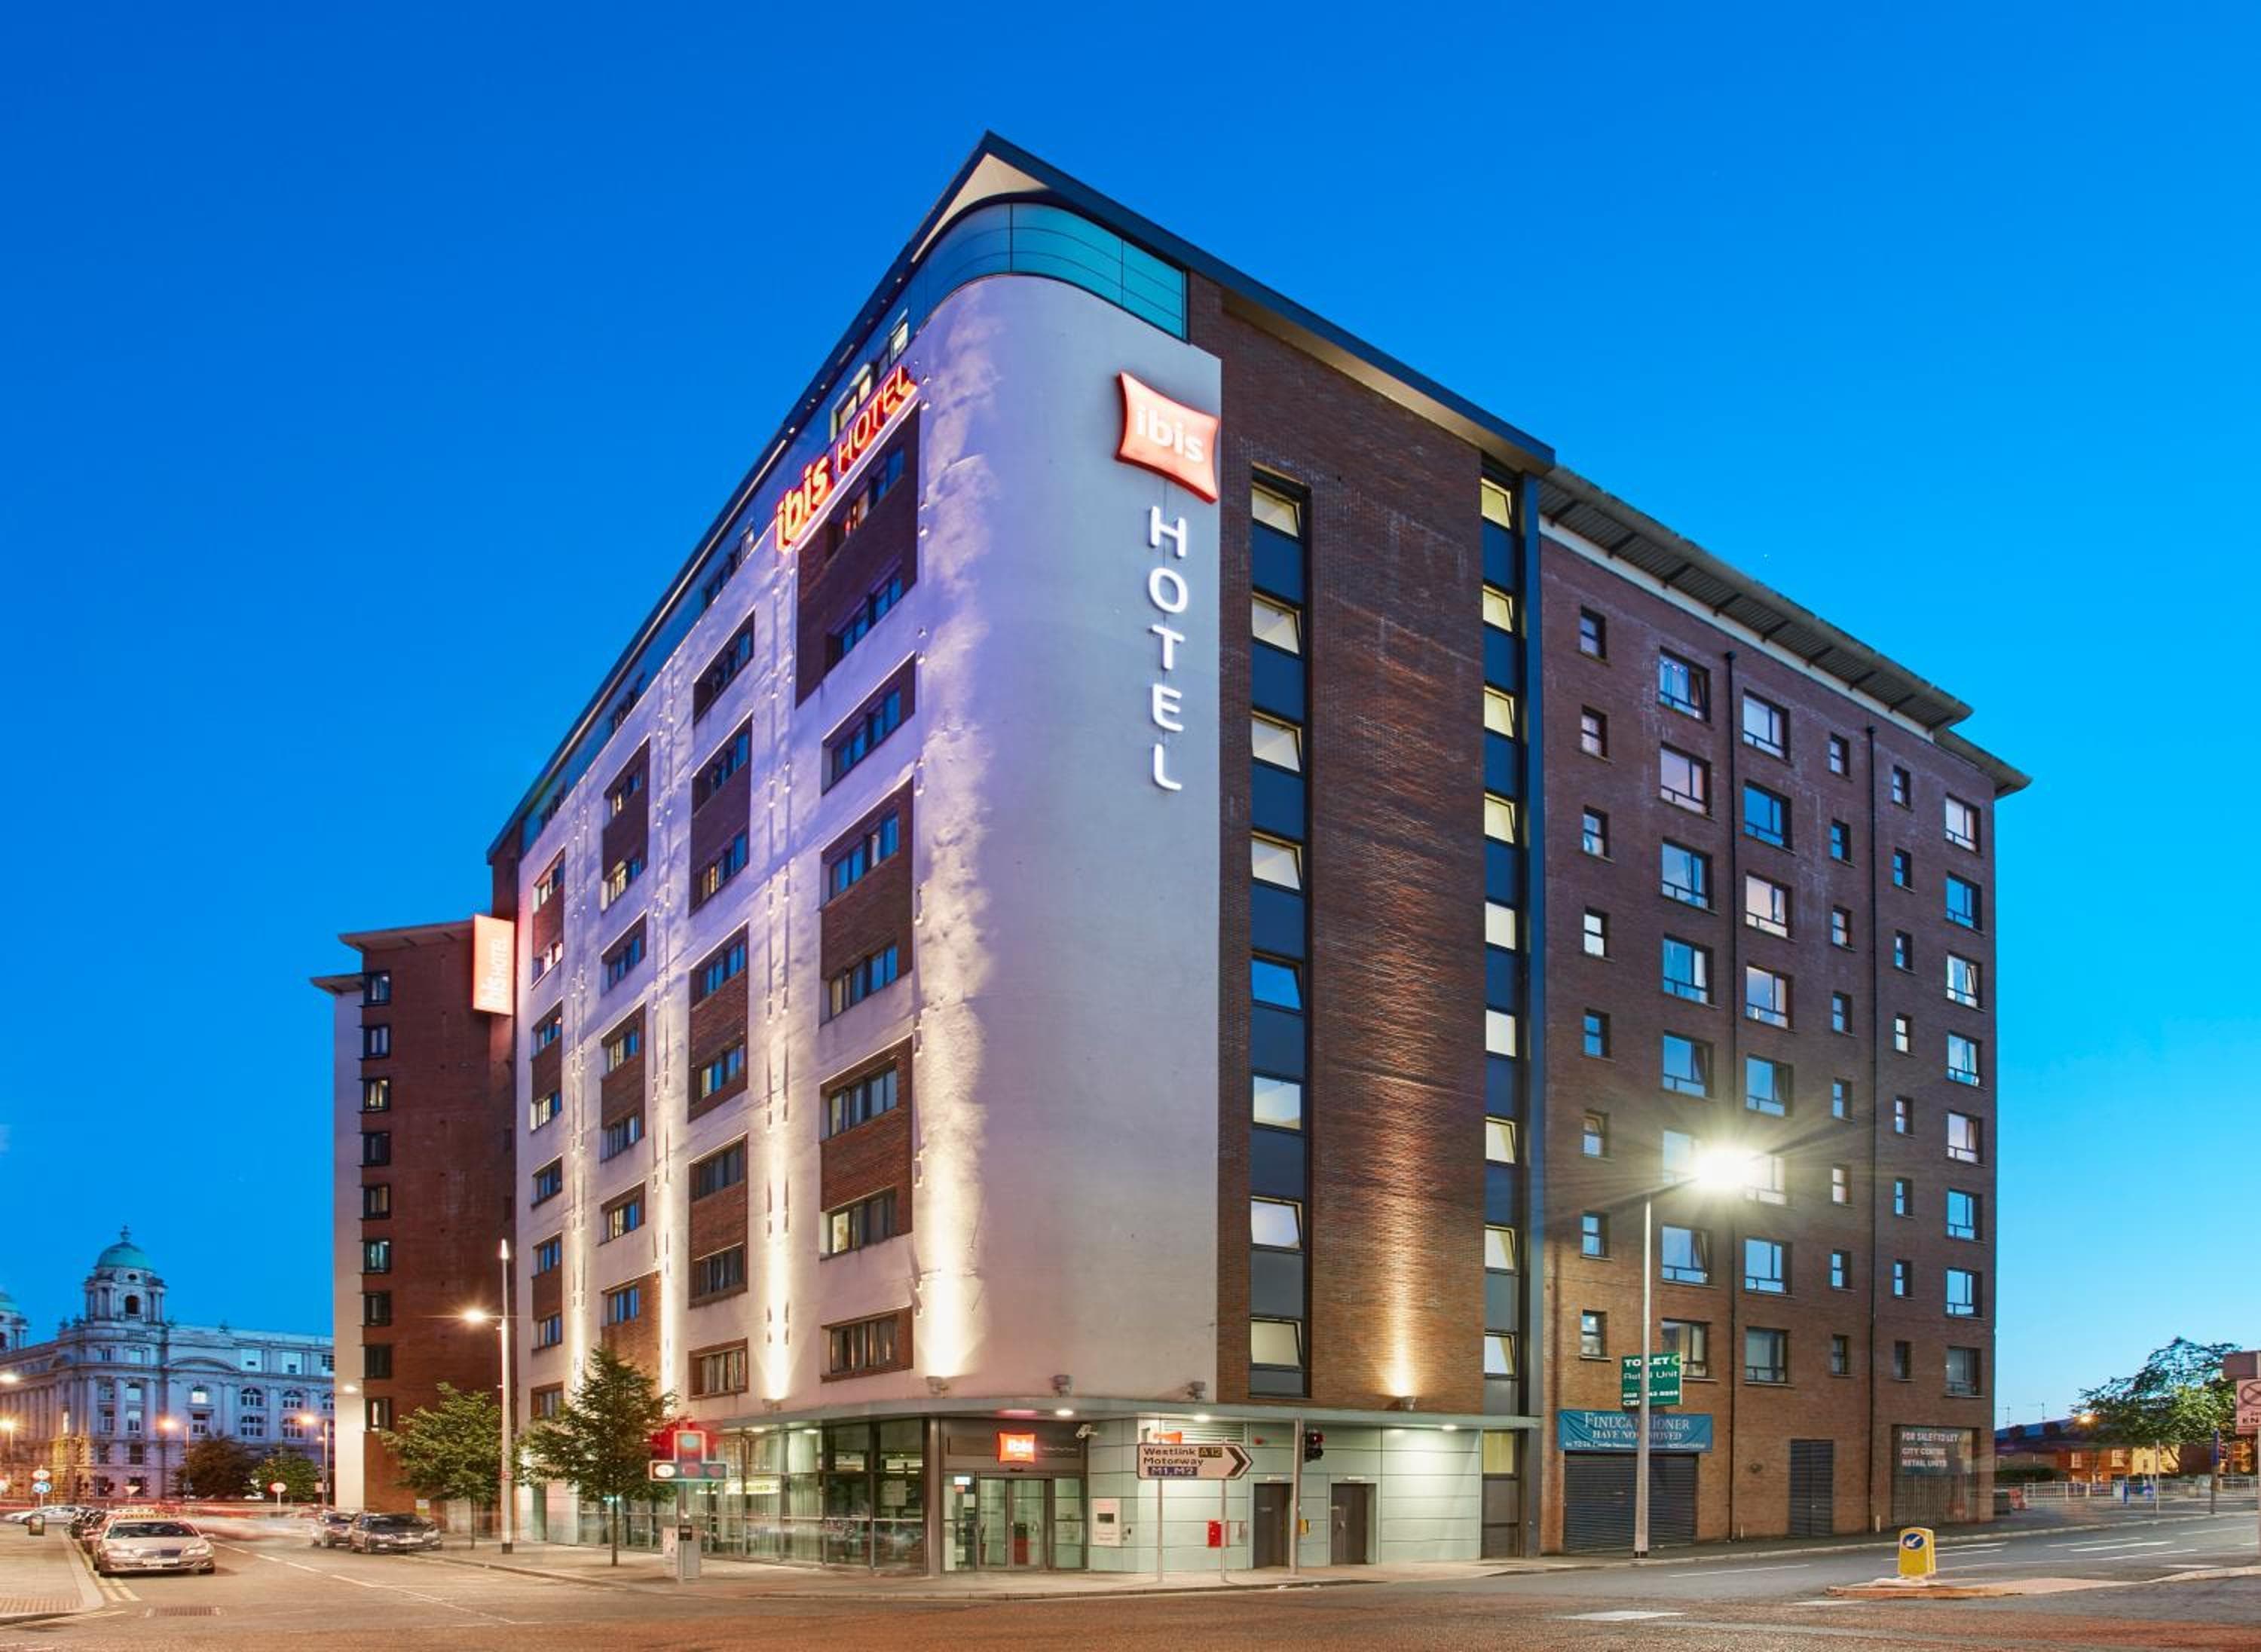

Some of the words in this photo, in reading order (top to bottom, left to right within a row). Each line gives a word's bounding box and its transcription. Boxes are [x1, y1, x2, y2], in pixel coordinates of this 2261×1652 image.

[1136, 407, 1204, 462] ibis
[776, 455, 830, 553] ibis
[837, 365, 910, 473] HOTEL
[1149, 506, 1188, 791] HOTEL
[1623, 1359, 1641, 1367] TO
[1648, 1357, 1669, 1366] ET
[1584, 1412, 1640, 1430] FINUCA
[1592, 1430, 1617, 1439] HAVE
[1623, 1430, 1640, 1439] NO
[1143, 1458, 1204, 1467] Motorway
[1174, 1467, 1193, 1476] M2
